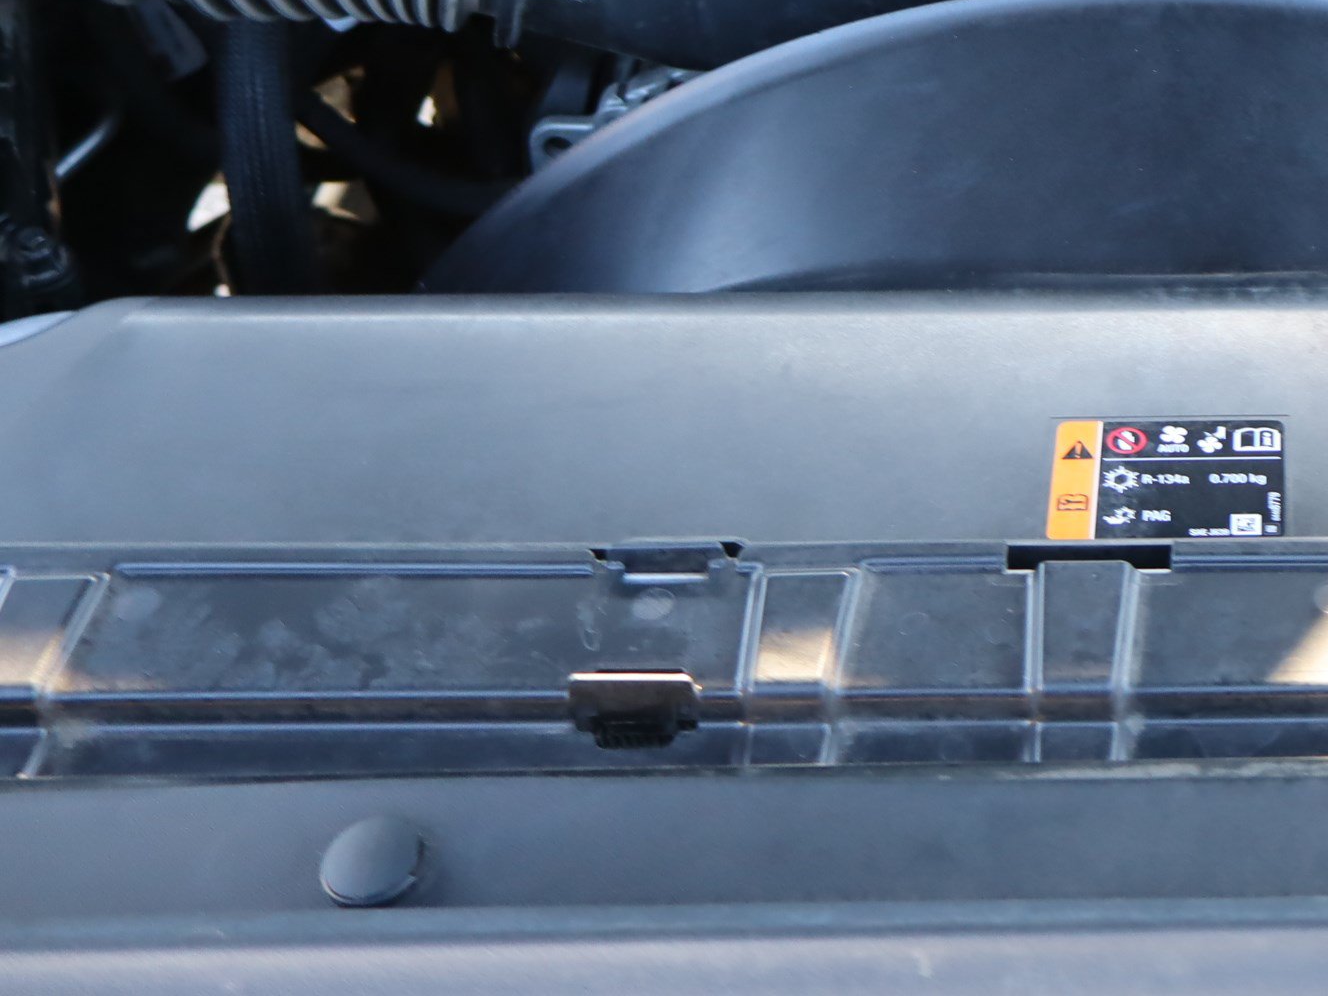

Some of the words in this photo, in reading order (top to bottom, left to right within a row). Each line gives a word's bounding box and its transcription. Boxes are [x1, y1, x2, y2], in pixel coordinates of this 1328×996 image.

[1157, 444, 1189, 453] AUTO
[1141, 473, 1190, 484] R-134a
[1208, 473, 1247, 484] 0.700
[1248, 473, 1267, 486] kg
[1141, 510, 1171, 521] PAG
